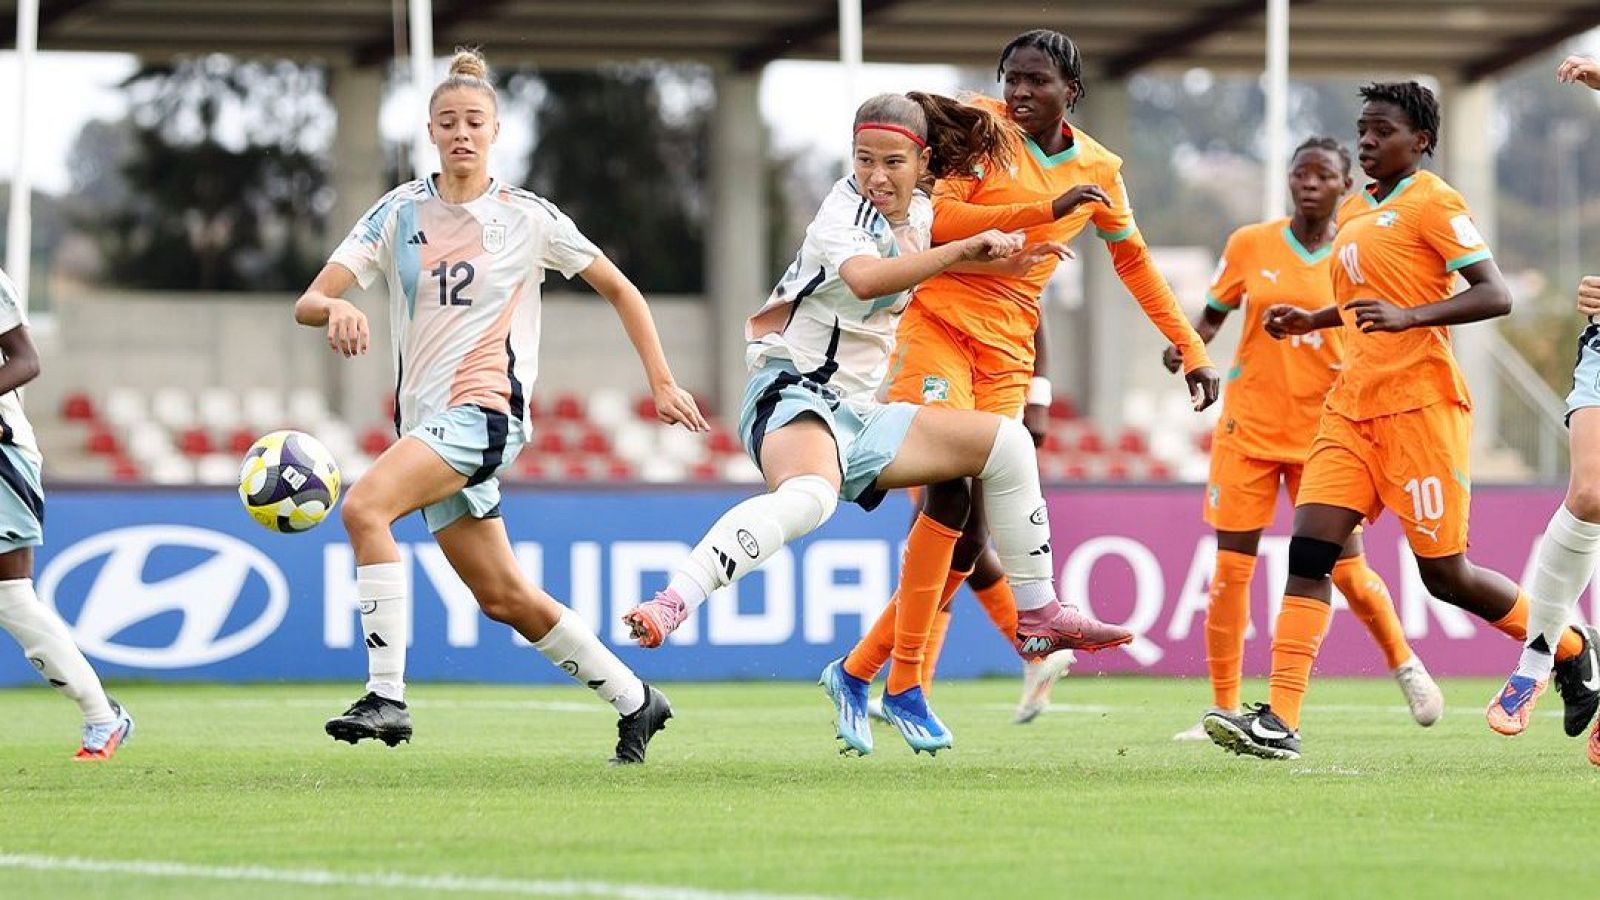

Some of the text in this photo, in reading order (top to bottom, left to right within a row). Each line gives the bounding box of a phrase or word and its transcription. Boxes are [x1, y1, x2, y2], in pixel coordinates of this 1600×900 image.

[431, 260, 475, 306] 12
[1403, 475, 1444, 521] 10
[323, 539, 908, 648] HYUNDA
